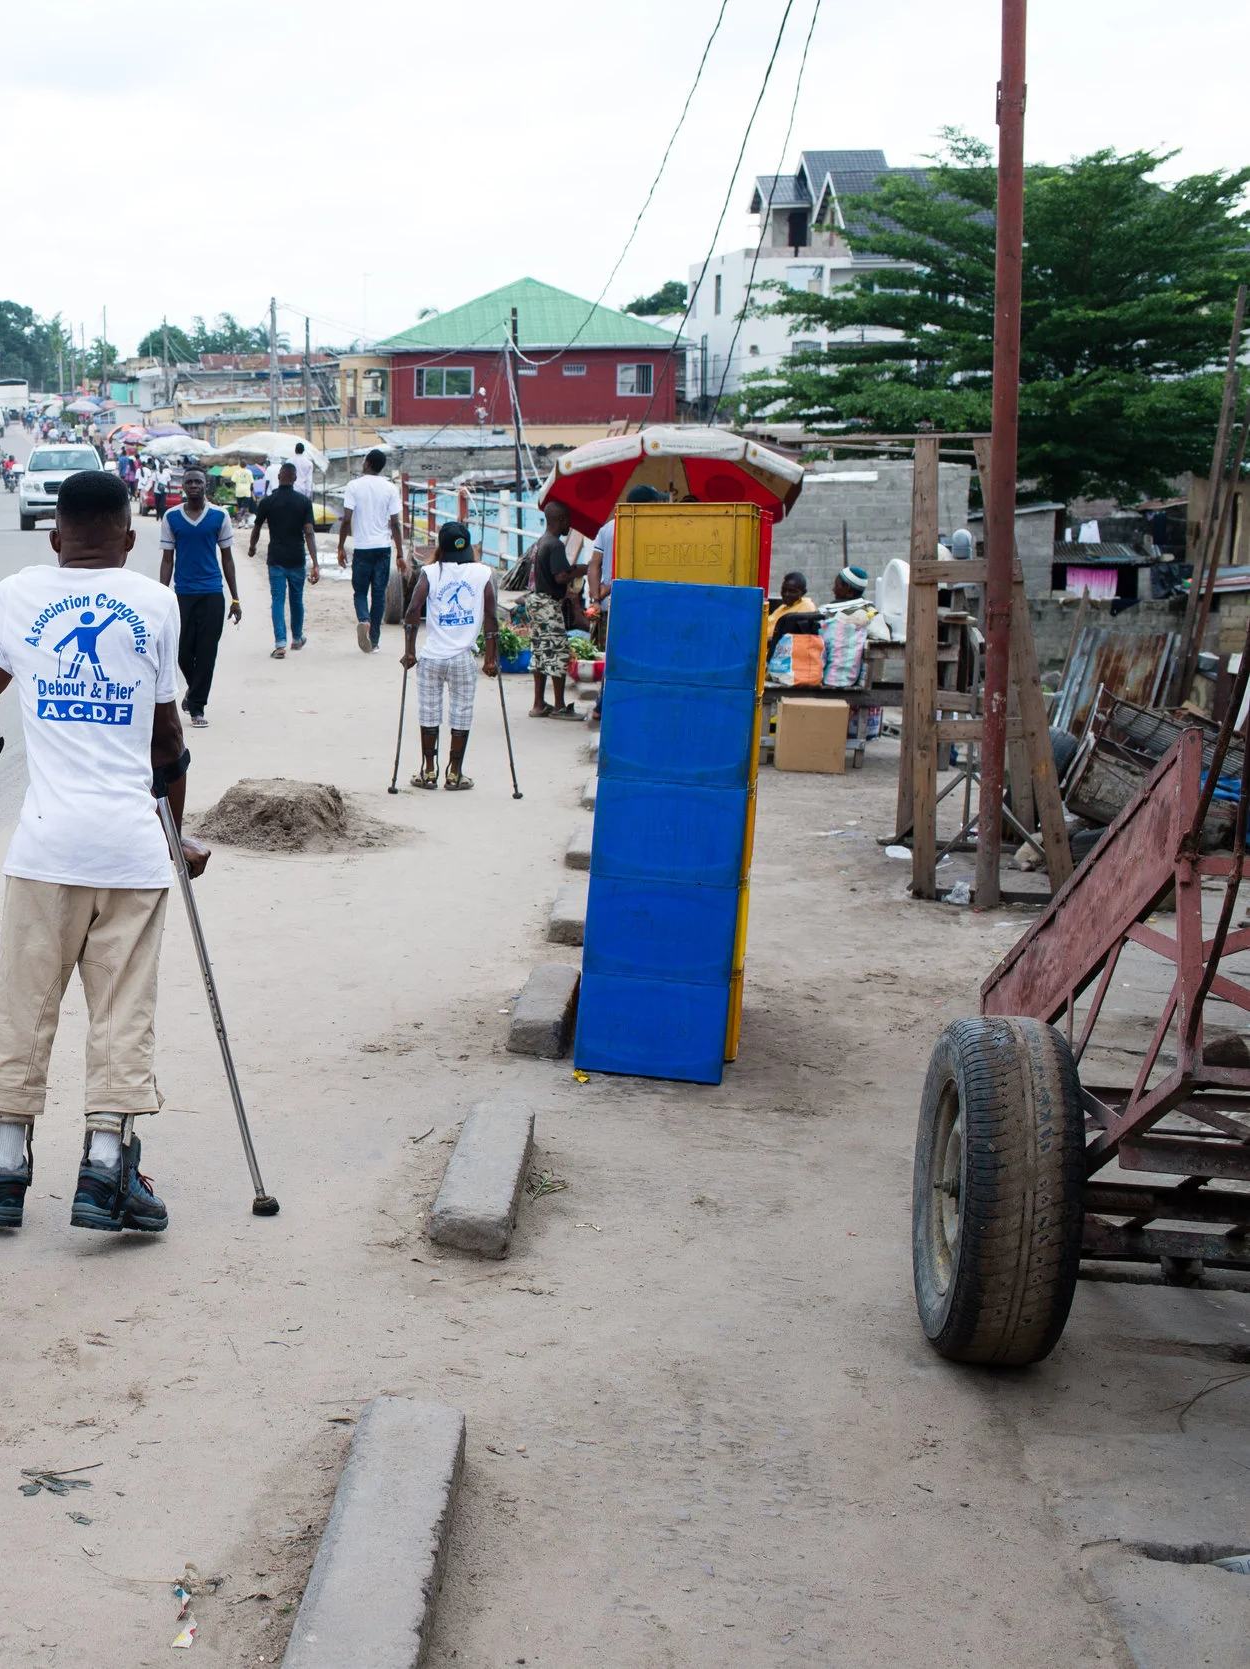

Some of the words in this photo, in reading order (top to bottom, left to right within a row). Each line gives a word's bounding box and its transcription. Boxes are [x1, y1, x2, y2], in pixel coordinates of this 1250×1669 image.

[644, 543, 722, 565] PRIMUS
[24, 595, 90, 648] Association
[95, 593, 151, 655] Congolaise
[91, 682, 102, 699] &
[41, 701, 129, 723] A.C.D.F
